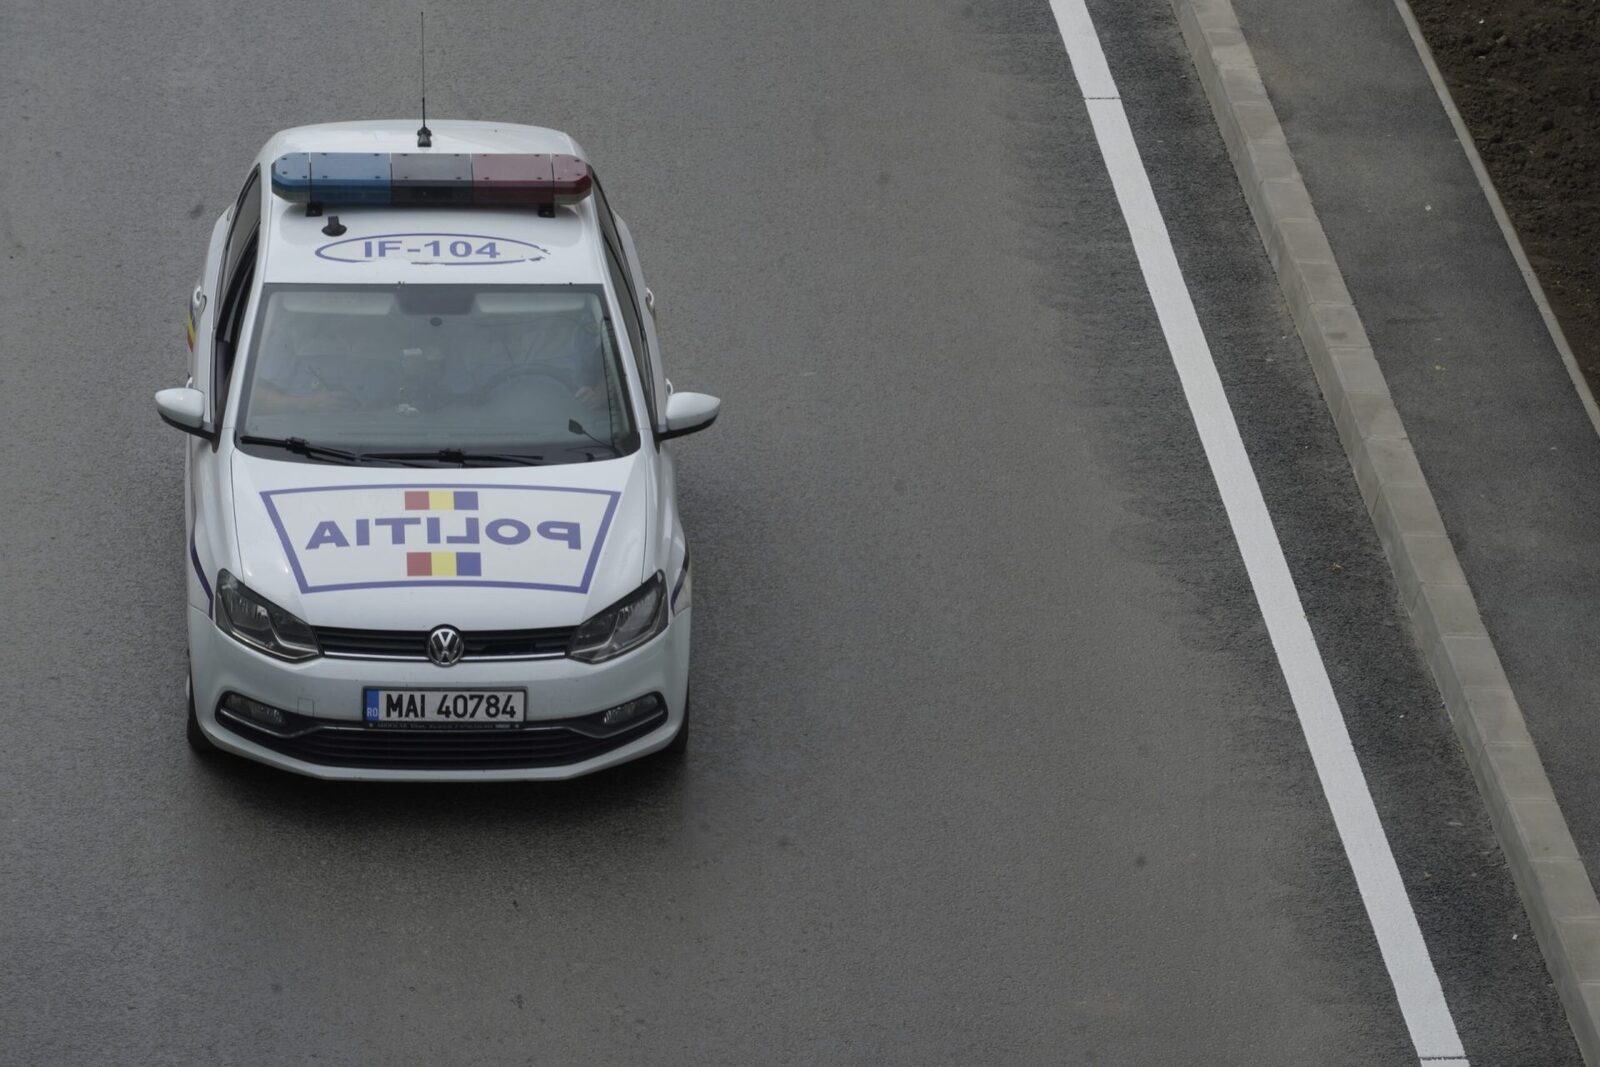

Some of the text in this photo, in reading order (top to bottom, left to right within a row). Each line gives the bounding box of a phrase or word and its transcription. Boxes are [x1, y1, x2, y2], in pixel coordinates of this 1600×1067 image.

[364, 240, 501, 258] IF-104
[367, 707, 378, 717] RO
[386, 694, 516, 718] MAI 40784
